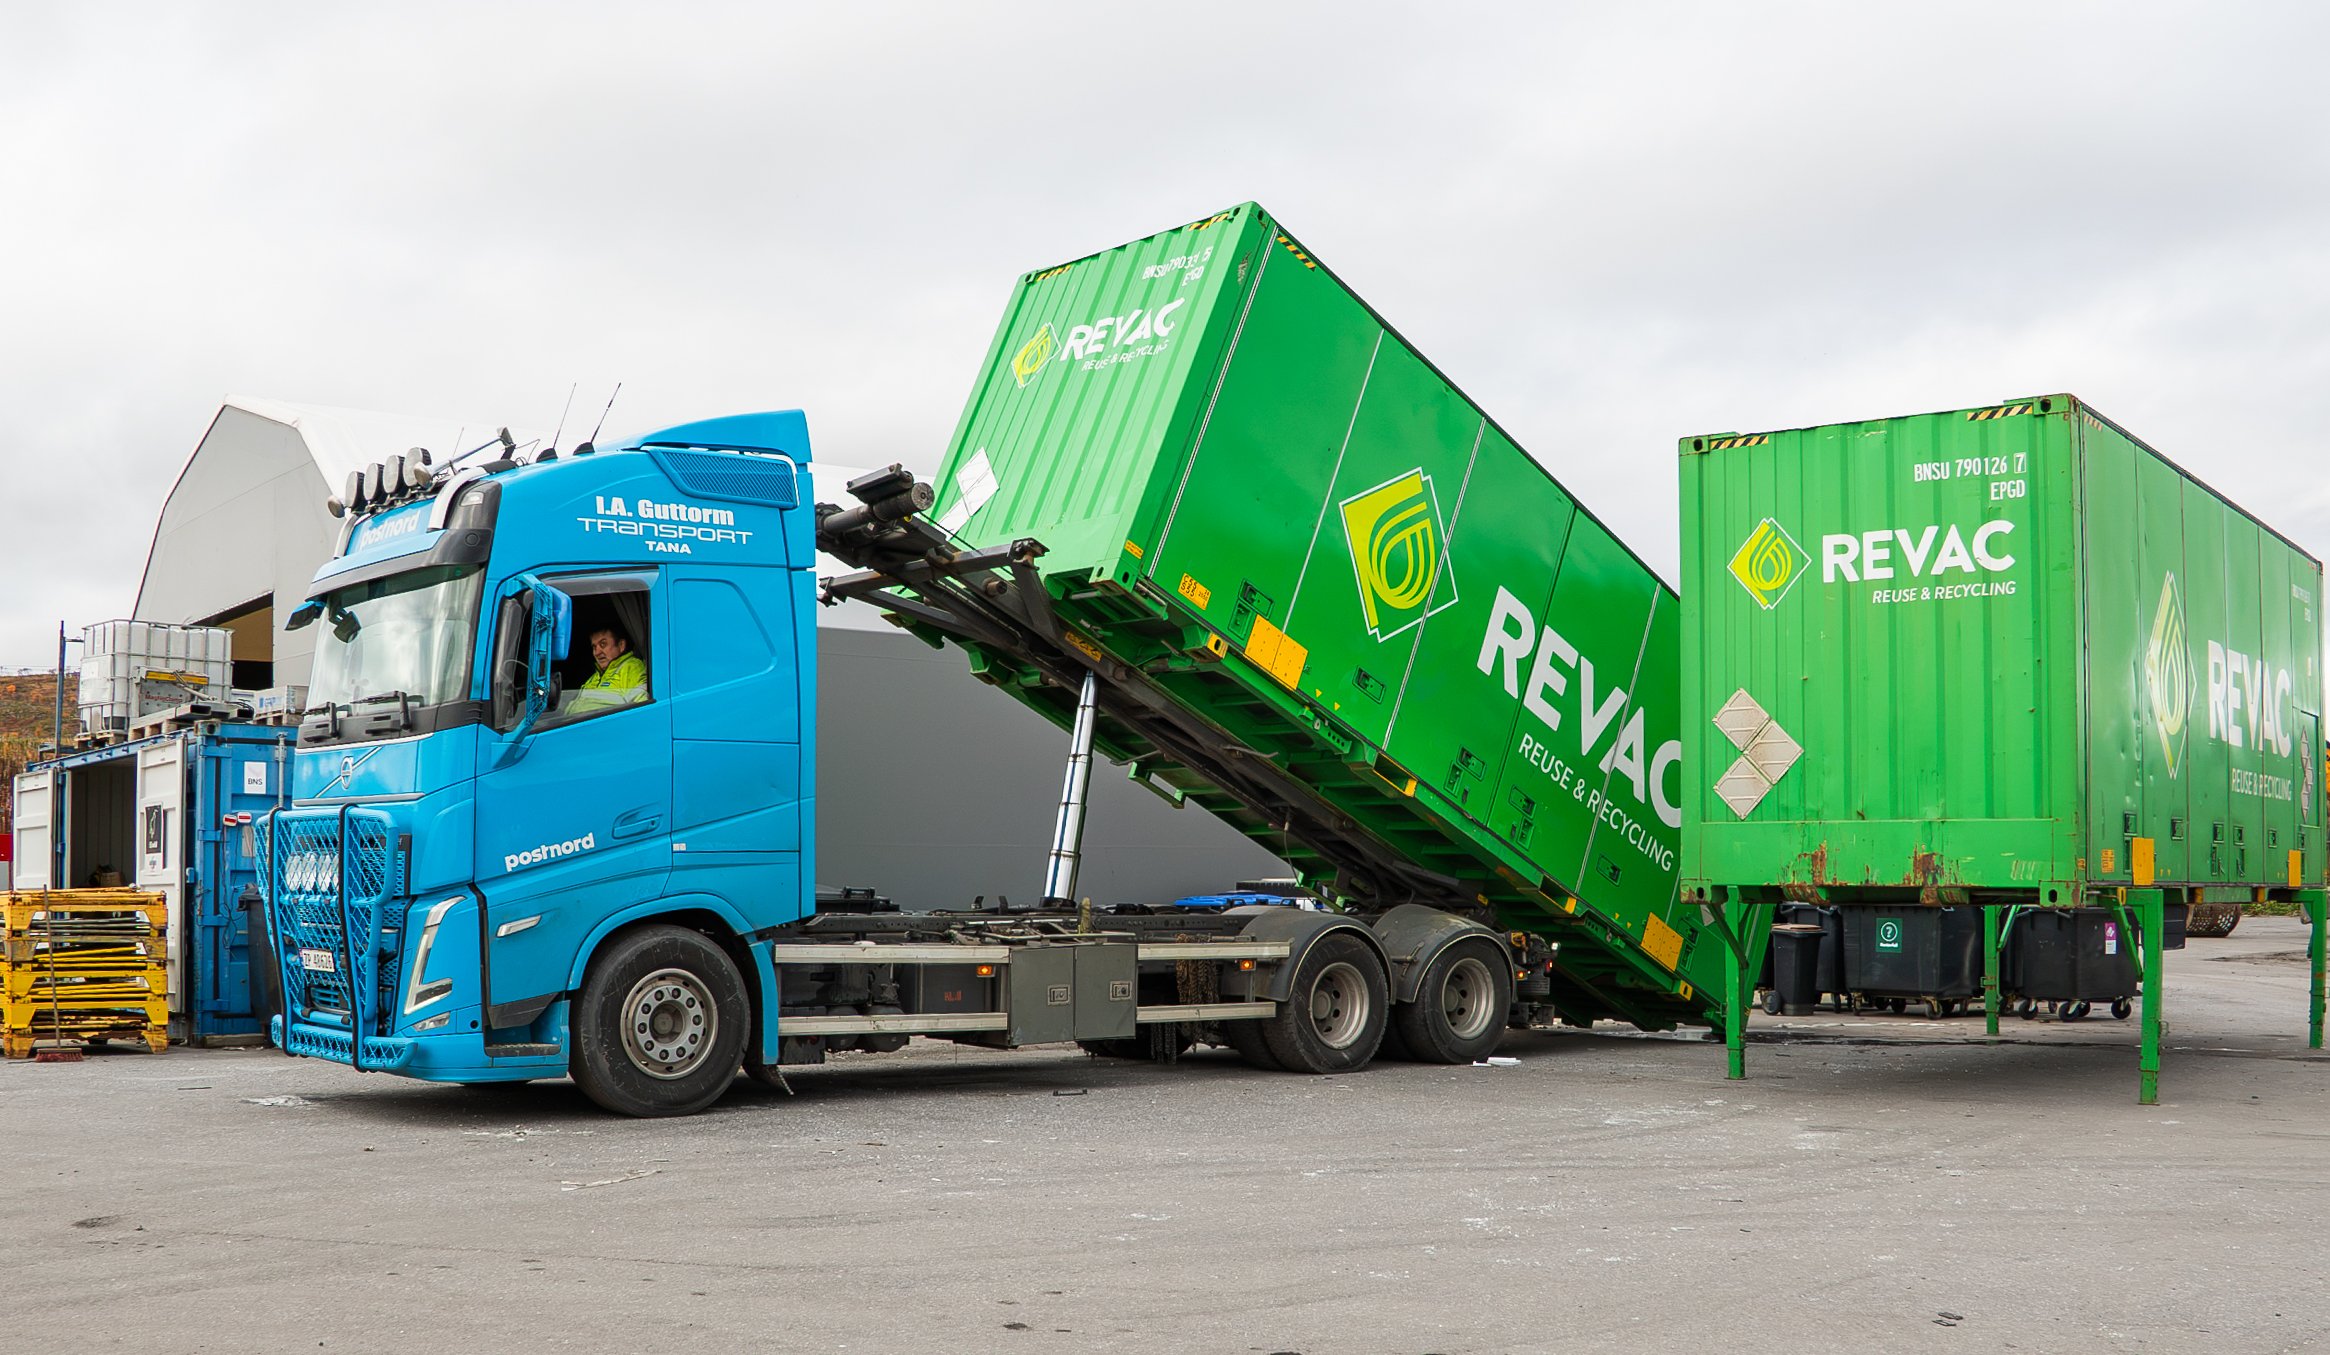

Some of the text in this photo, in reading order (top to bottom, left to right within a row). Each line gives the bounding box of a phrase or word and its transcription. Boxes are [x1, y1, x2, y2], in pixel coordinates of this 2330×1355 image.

[1060, 297, 1185, 361] REVAC
[1913, 453, 2025, 482] BNSU 790126 7
[1990, 479, 2026, 501] EPGD
[595, 495, 735, 526] I.A. Guttorm
[360, 508, 421, 551] postnord
[645, 540, 692, 554] TANA
[1822, 519, 2016, 584] REVAC
[1872, 580, 2017, 604] REUSE & RECYCLING
[2208, 639, 2292, 758] REVAC
[247, 778, 263, 786] BNS
[2232, 767, 2253, 795] REUSE
[2258, 774, 2292, 801] RECYCLING
[1518, 732, 1674, 872] REUSE & RECYCLING
[504, 832, 595, 872] postnord
